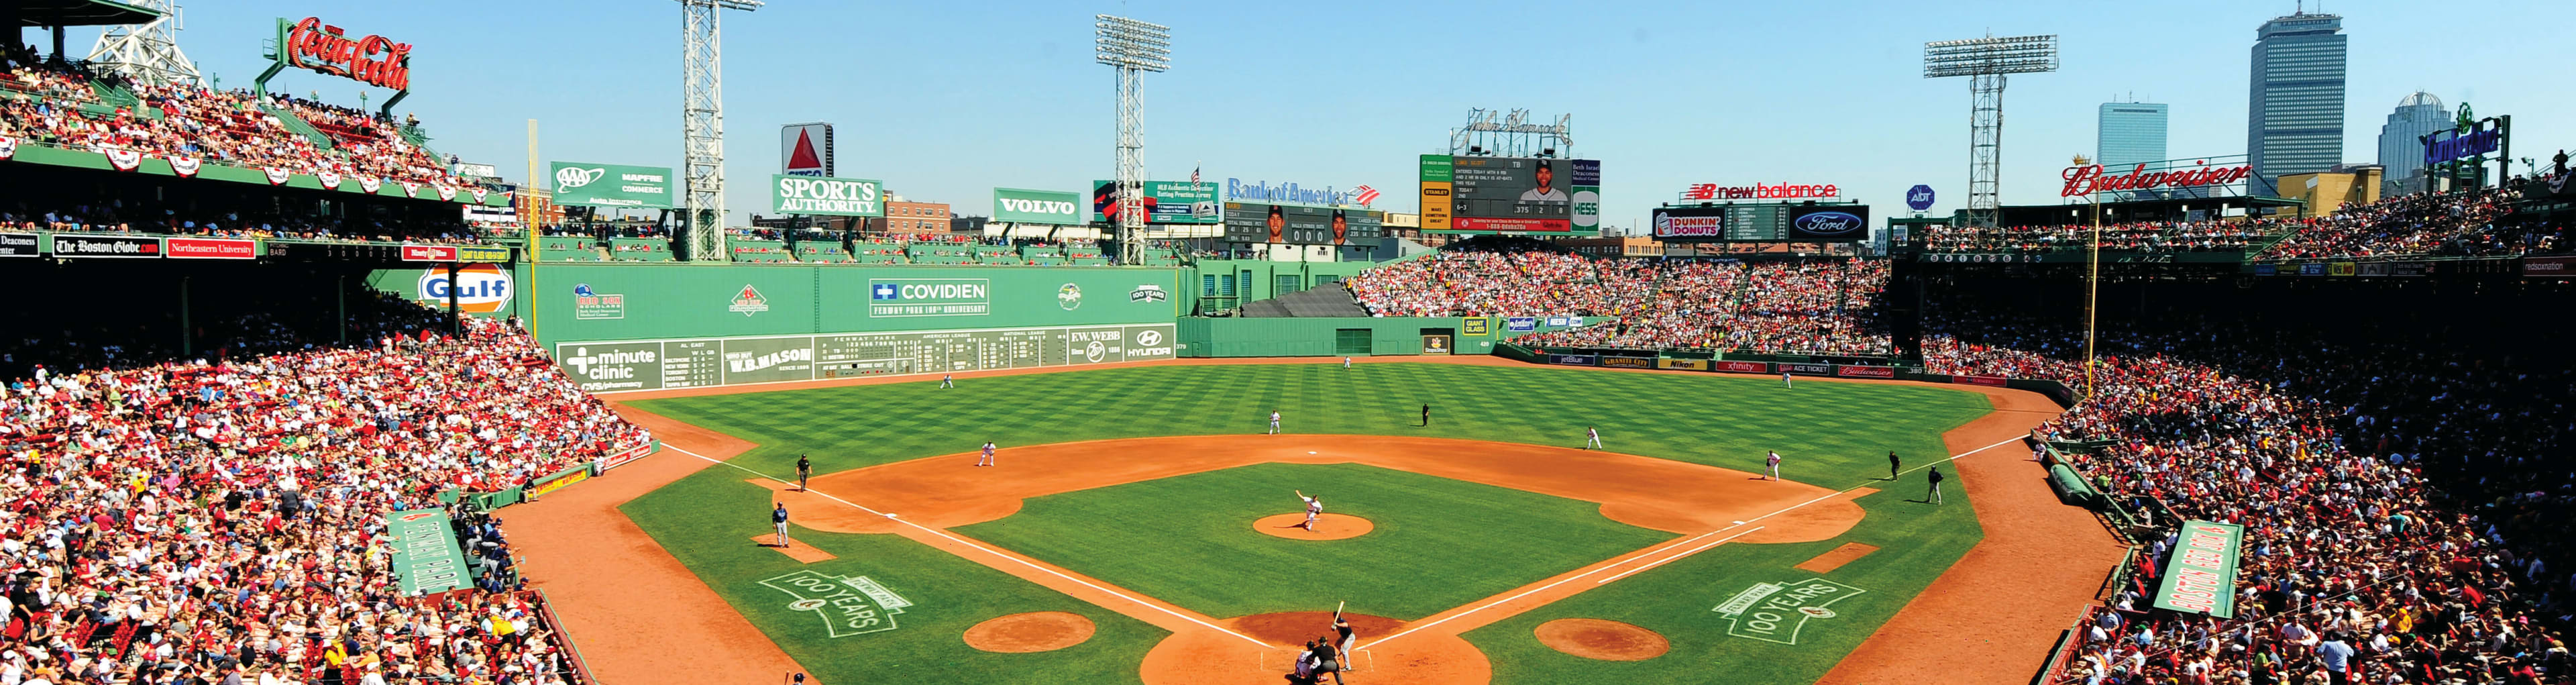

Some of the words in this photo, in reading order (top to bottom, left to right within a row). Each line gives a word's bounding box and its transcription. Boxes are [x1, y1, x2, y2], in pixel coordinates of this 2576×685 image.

[288, 17, 412, 91] Coca-Cola
[1453, 107, 1500, 150] John
[1501, 108, 1573, 146] Hancock
[560, 168, 586, 186] AAA
[622, 174, 663, 182] MAPFRE
[2061, 160, 2253, 197] Budweiser
[780, 178, 875, 201] SPORTS
[1228, 177, 1270, 199] Bank
[1272, 181, 1288, 201] of
[1289, 182, 1348, 205] America
[1719, 187, 1755, 199] new
[1758, 181, 1835, 198] balance
[1911, 193, 1931, 201] ADT
[1000, 198, 1075, 215] VOLVO
[1574, 203, 1597, 215] HESS
[1674, 217, 1719, 226] DUNKIN'
[1807, 215, 1847, 231] Ford
[1294, 231, 1299, 241] 0
[1305, 231, 1311, 242] 0
[1318, 231, 1323, 242] 0
[1674, 226, 1717, 235] DONUTS
[1, 235, 35, 246] Deaconess
[56, 240, 75, 253] The
[78, 240, 112, 253] Boston
[172, 243, 217, 252] Northeastern
[219, 244, 252, 255] University
[427, 278, 504, 297] Gulf
[902, 284, 984, 299] COVIDIEN
[602, 297, 621, 305] SOX
[1132, 291, 1144, 299] 100
[906, 306, 923, 314] PARK
[1093, 331, 1120, 341] WEBB
[598, 349, 655, 364] minute
[1128, 348, 1171, 357] HYUNDAI
[1561, 356, 1582, 364] jetBlue
[1605, 357, 1633, 365] GRANITE
[1634, 358, 1648, 366] CITY
[1670, 360, 1695, 368] Nikon
[1728, 362, 1755, 371] xfinity
[590, 364, 633, 380] clinic
[1841, 366, 1892, 376] Budweiser
[2189, 531, 2227, 552] SOX
[2182, 549, 2223, 570] RED
[1760, 584, 1838, 611] YEARS
[2168, 568, 2219, 613] BOSTON
[786, 576, 836, 592] 100
[824, 590, 880, 629] YEARS
[1746, 612, 1782, 635] 100
